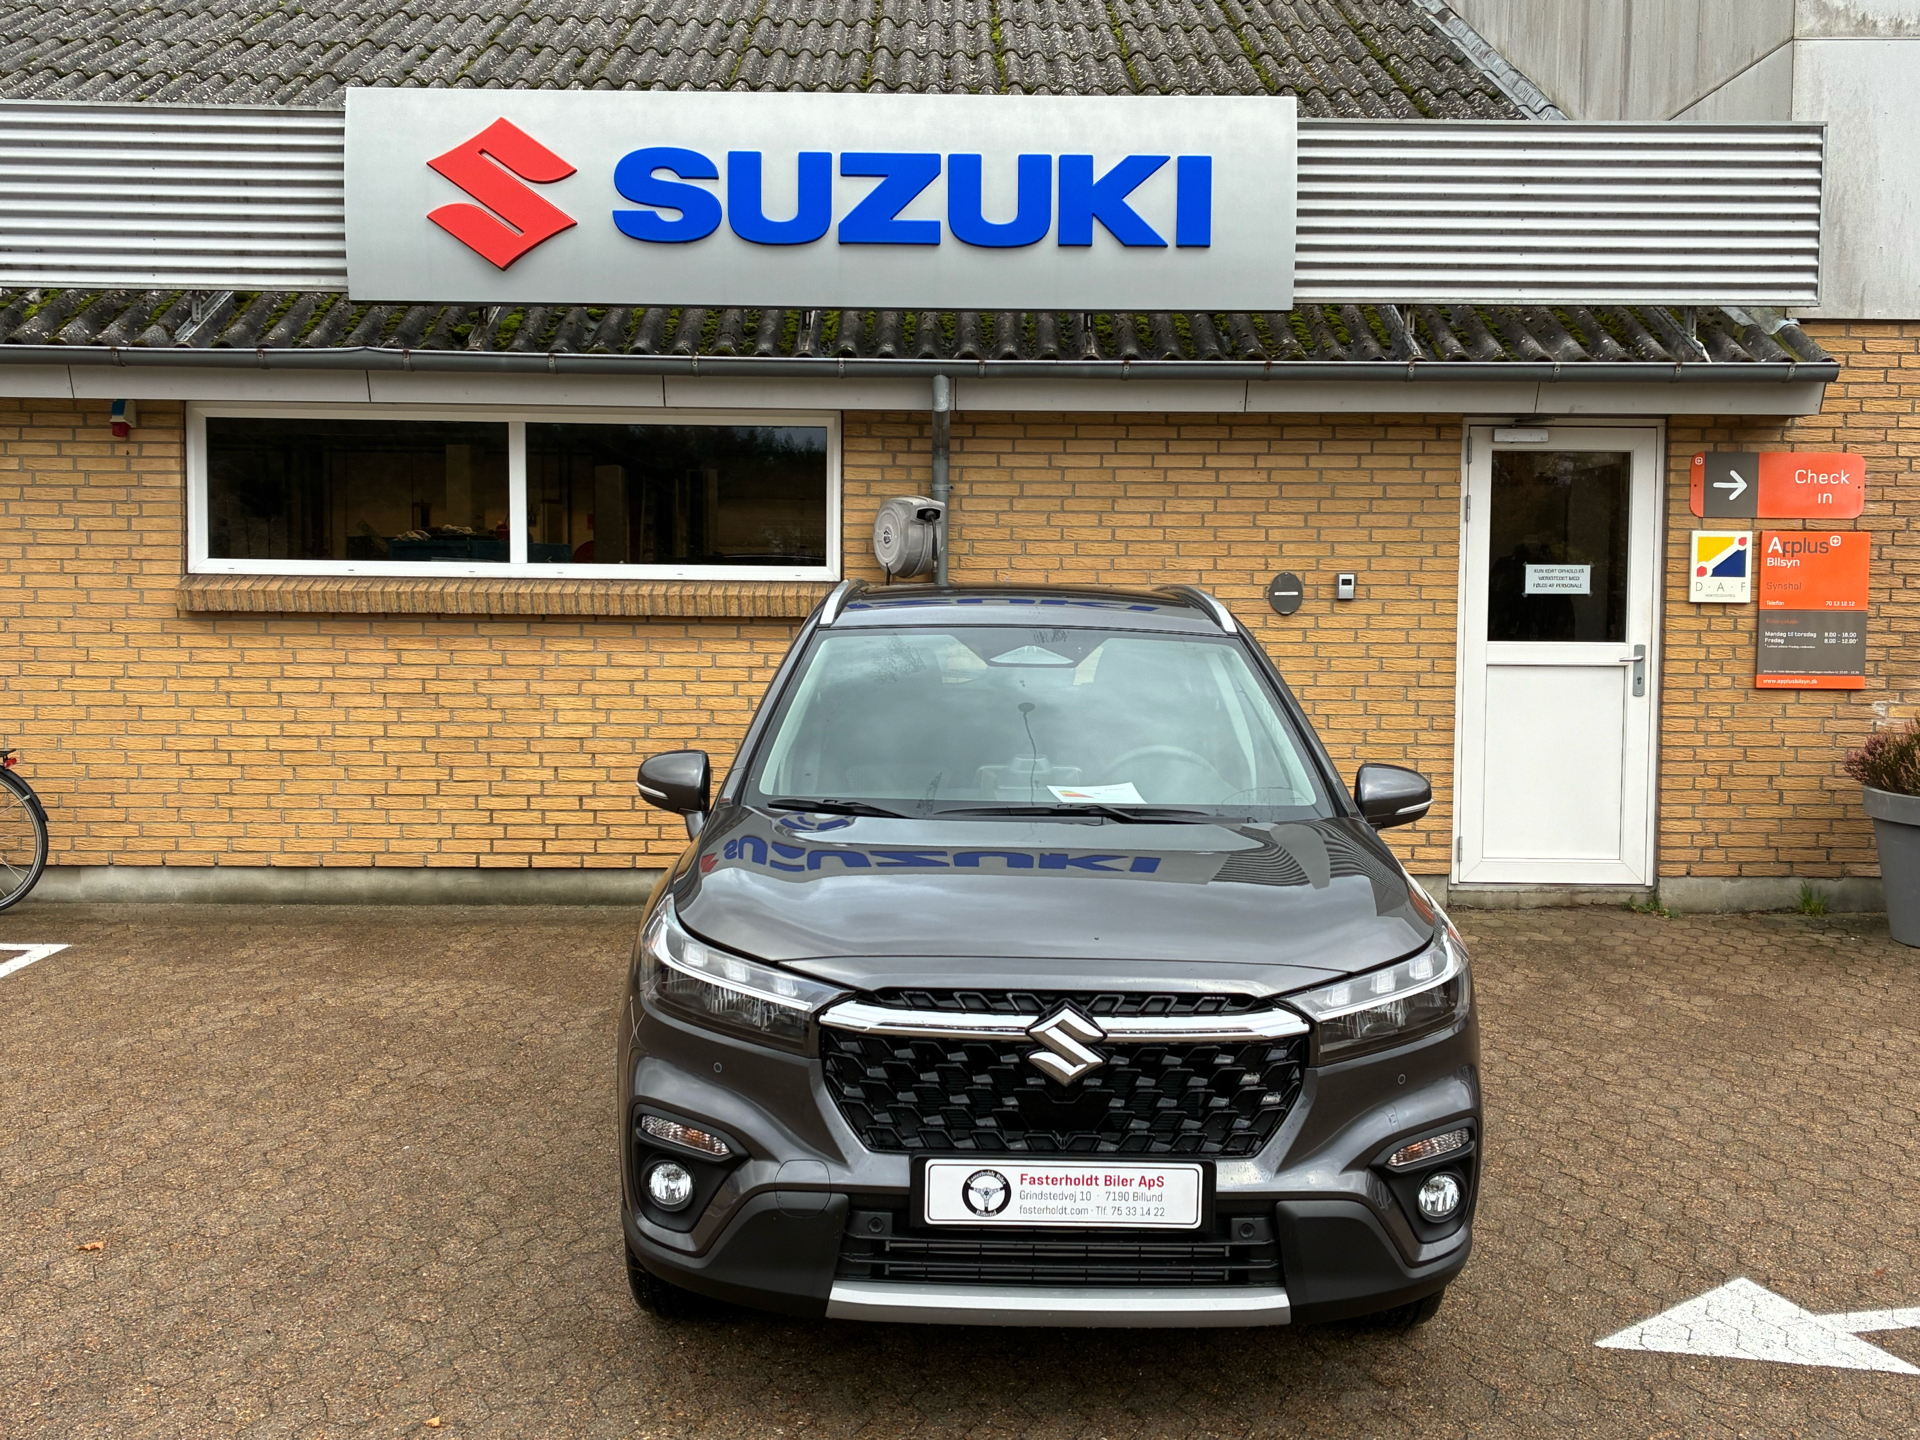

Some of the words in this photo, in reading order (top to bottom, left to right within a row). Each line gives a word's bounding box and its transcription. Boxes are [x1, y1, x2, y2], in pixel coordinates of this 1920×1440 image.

[612, 146, 1212, 249] SUZUKI
[1794, 469, 1850, 485] Check
[1817, 493, 1833, 504] in
[1767, 536, 1830, 558] Applus
[1766, 557, 1800, 569] Bilsyn
[1020, 1173, 1100, 1186] Fasterholdt
[1104, 1175, 1135, 1187] Biler
[1138, 1176, 1164, 1190] ApS
[1020, 1190, 1076, 1204] Grindstedvej
[1080, 1191, 1092, 1202] 10
[1106, 1191, 1130, 1202] 7190
[1132, 1191, 1163, 1202] Billund
[1019, 1204, 1088, 1215] fasterholdt.com
[1096, 1205, 1108, 1216] Tlf.
[1111, 1206, 1122, 1216] 75
[1126, 1206, 1137, 1216] 33
[1140, 1207, 1150, 1216] 14
[1153, 1207, 1165, 1217] 22
